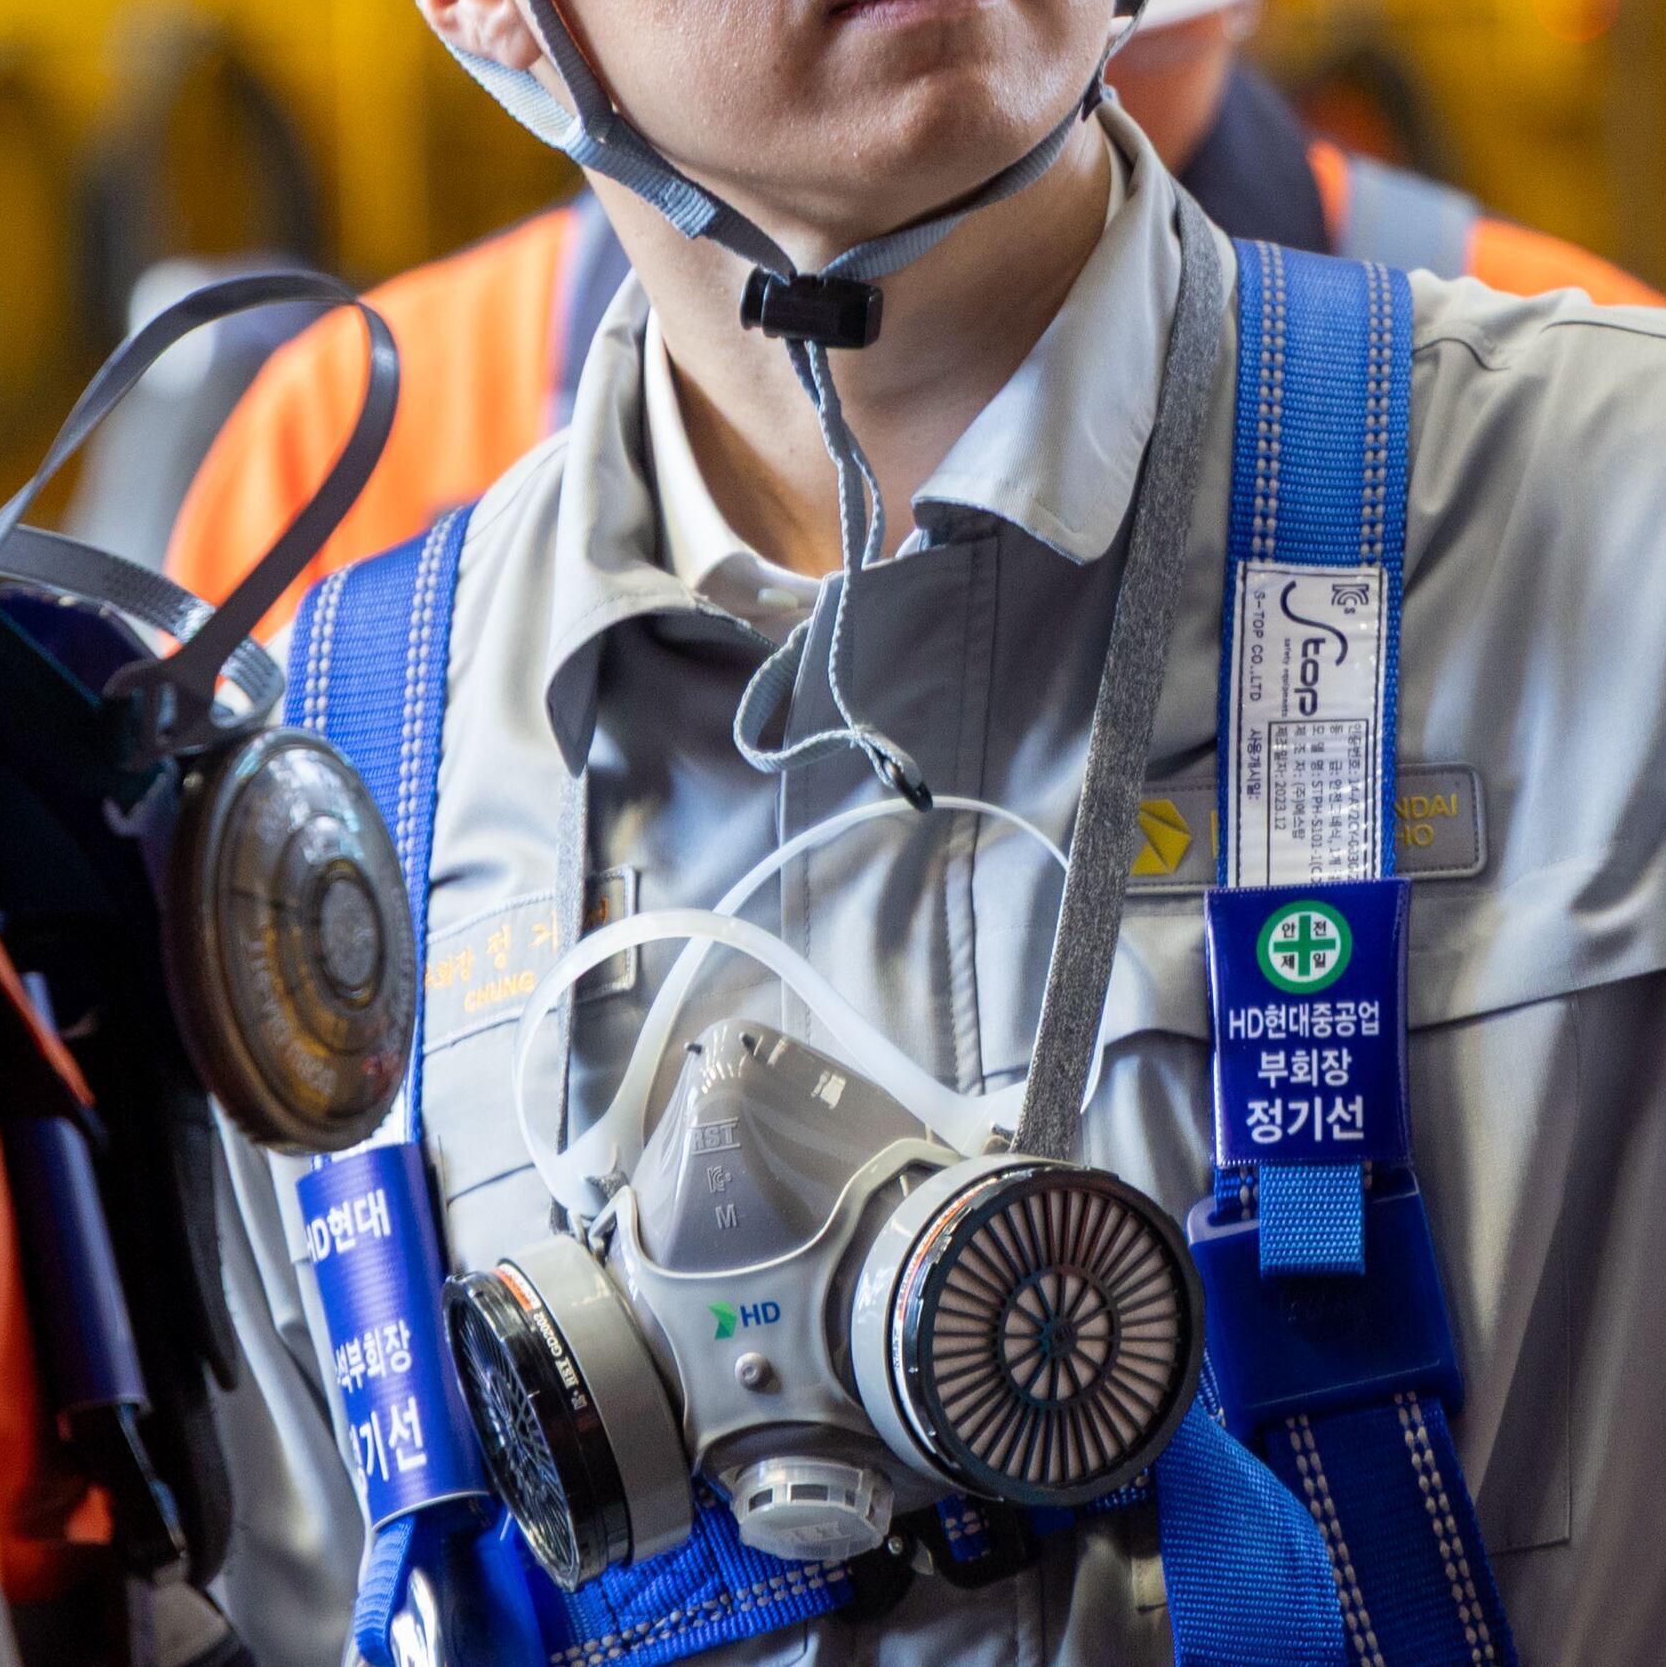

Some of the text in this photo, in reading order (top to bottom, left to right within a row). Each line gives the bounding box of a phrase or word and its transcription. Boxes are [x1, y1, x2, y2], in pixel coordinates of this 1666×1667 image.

[1252, 590, 1266, 639] S-TOP
[1247, 728, 1262, 800] 사용개시일:
[1274, 781, 1287, 831] 2023.12
[1396, 793, 1459, 820] NDAI
[464, 969, 537, 1014] CHUNG
[1229, 1000, 1380, 1040] HD현대중공업
[1257, 1047, 1352, 1089] 부회장
[1246, 1094, 1365, 1144] 정기선
[715, 1204, 739, 1230] M
[740, 1300, 781, 1328] HD
